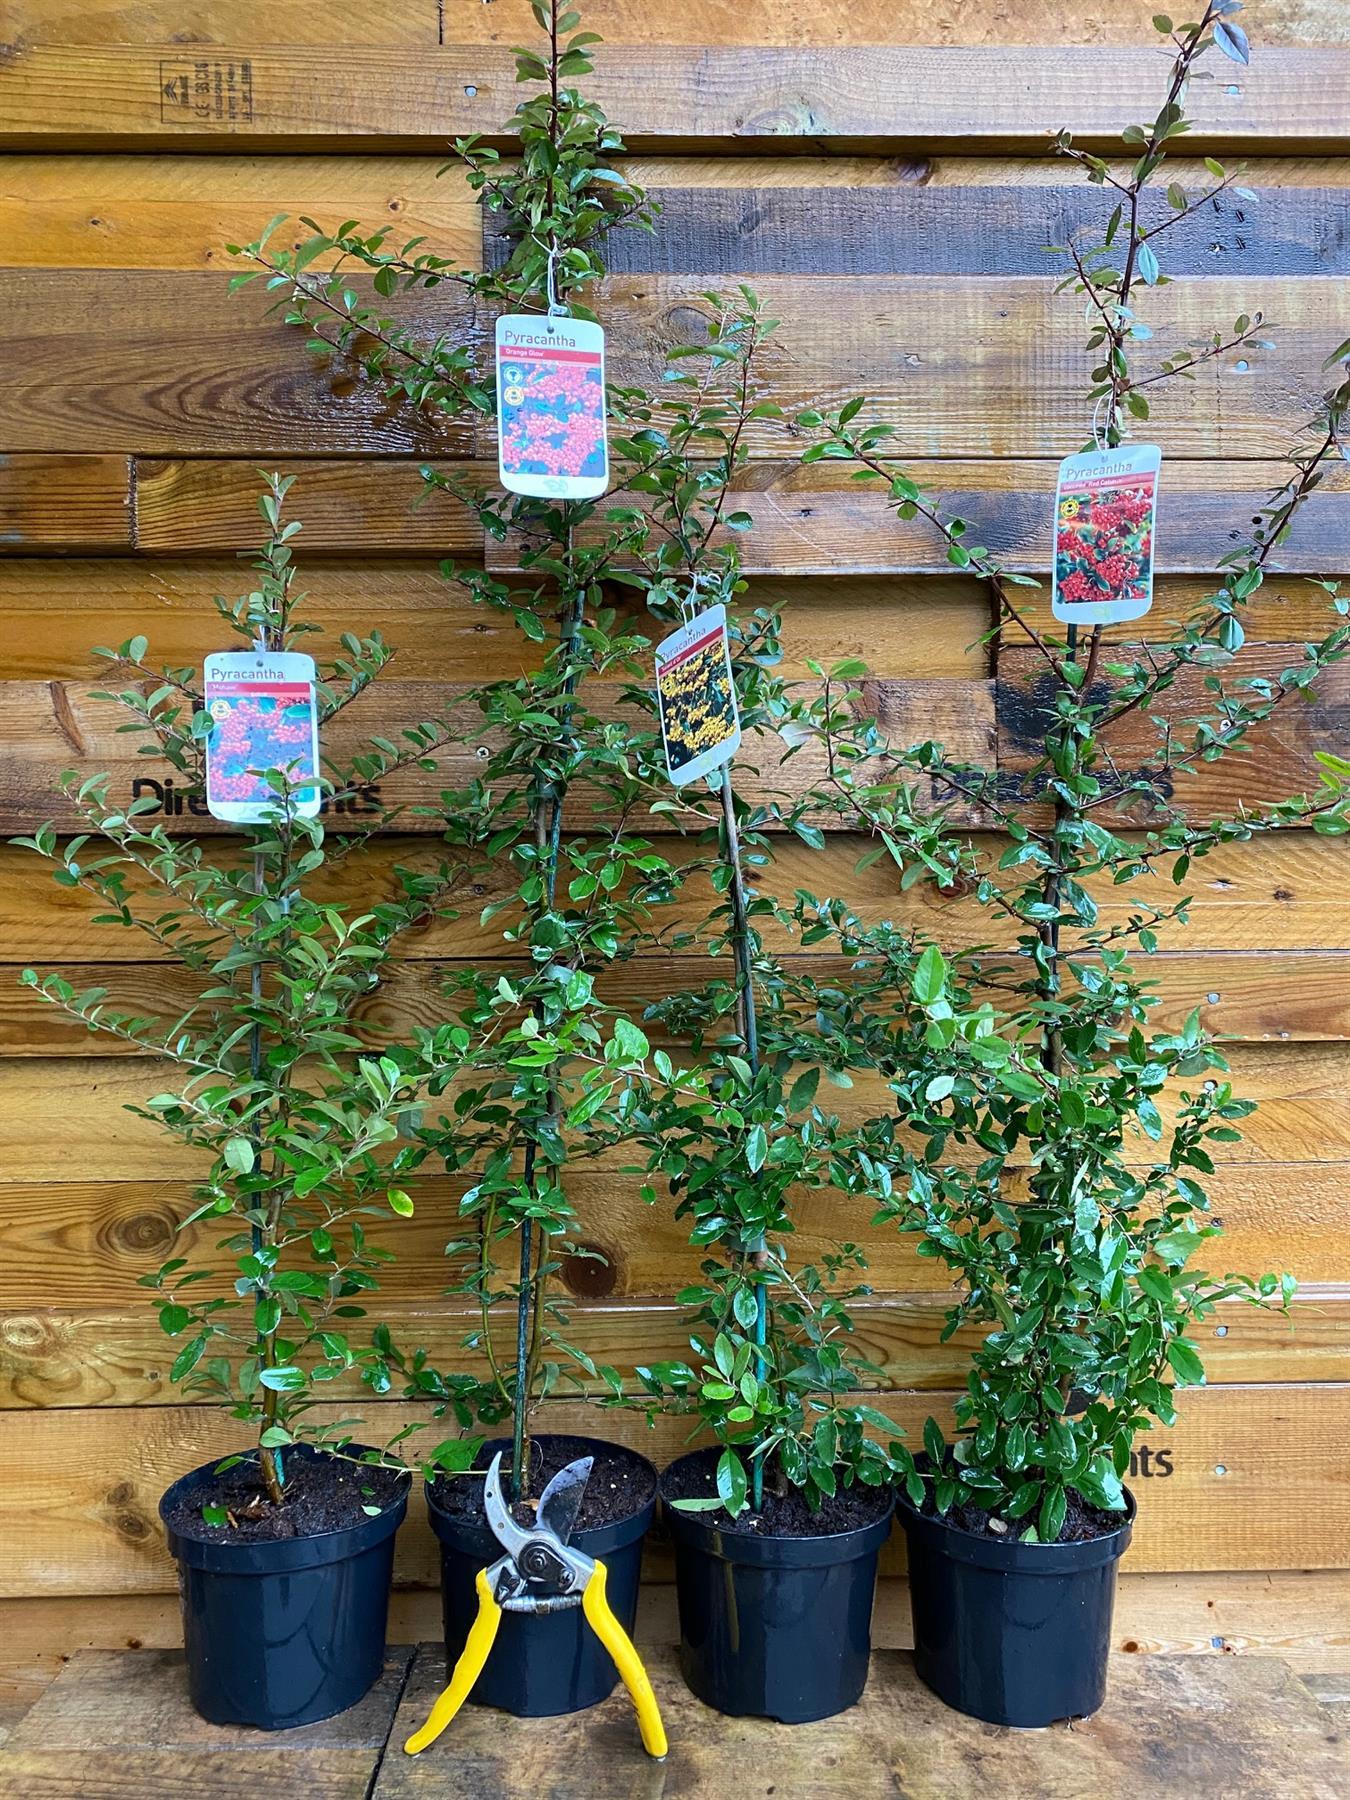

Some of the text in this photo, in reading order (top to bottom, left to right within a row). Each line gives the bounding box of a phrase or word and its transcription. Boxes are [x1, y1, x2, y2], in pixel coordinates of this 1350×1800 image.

[504, 330, 576, 348] Pyracantha
[1066, 462, 1132, 480] Pyracantha
[661, 627, 706, 660] Pyracantha
[211, 668, 284, 681] Pyracantha
